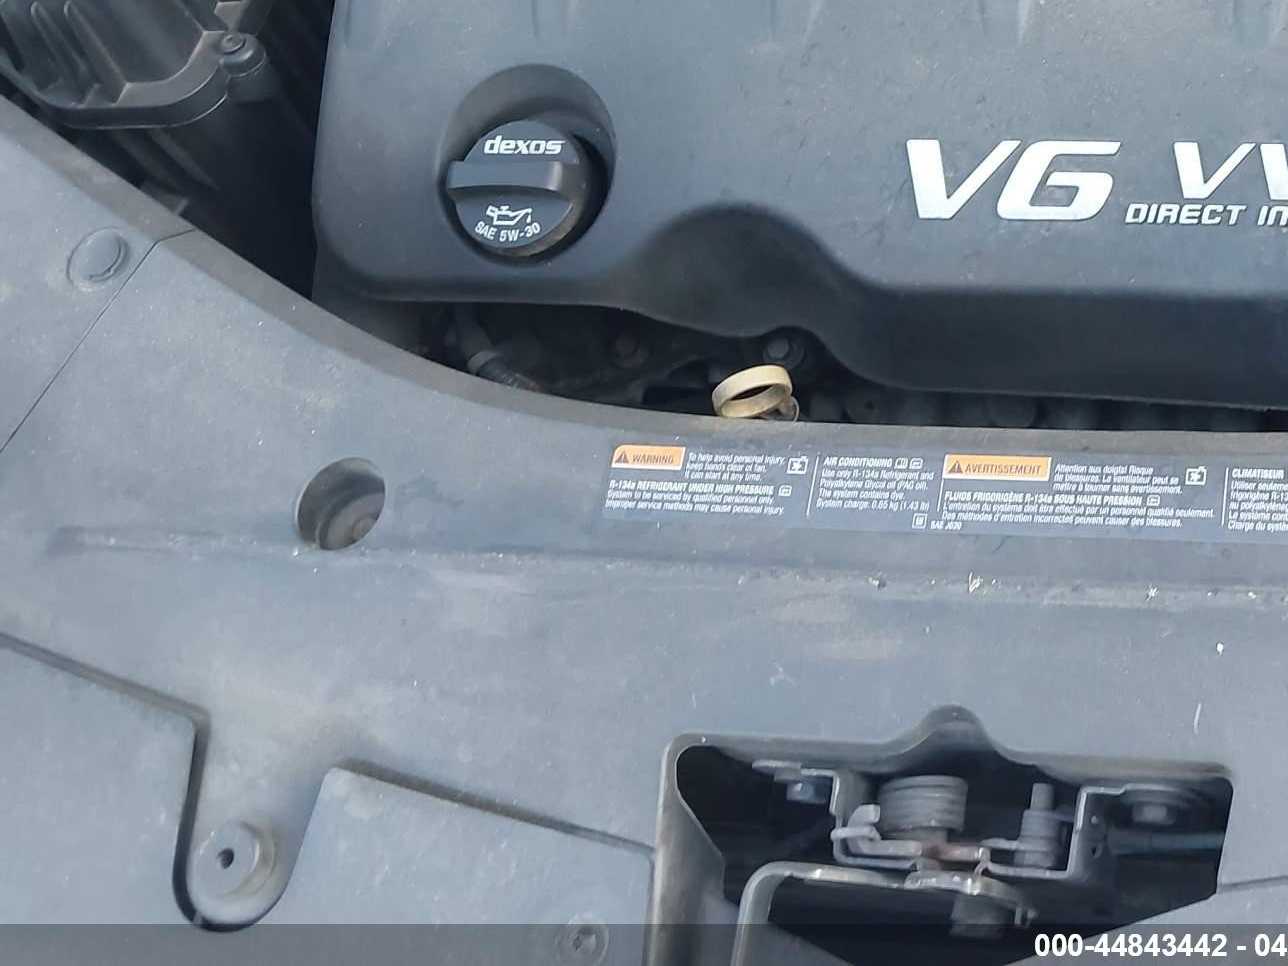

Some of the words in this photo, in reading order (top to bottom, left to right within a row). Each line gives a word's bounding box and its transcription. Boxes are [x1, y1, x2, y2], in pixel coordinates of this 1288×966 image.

[484, 135, 566, 155] dexos
[906, 138, 1121, 220] V6
[1124, 202, 1246, 225] DIRECT
[474, 220, 498, 240] SAE
[499, 221, 541, 243] 5W-30
[632, 453, 674, 465] WARNING
[689, 452, 697, 461] To
[698, 452, 713, 463] help
[713, 453, 733, 463] avoid
[732, 454, 764, 466] personal
[823, 456, 838, 467] AIR
[838, 456, 893, 469] CONDITIONING
[686, 461, 703, 472] keep
[704, 462, 726, 472] hands
[726, 463, 744, 473] clear
[744, 464, 753, 473] of
[965, 463, 1041, 475] AVERTISSEMENT
[1055, 462, 1088, 476] Attention
[1088, 464, 1103, 475] aux
[1232, 468, 1284, 480] CLIMATISEUR
[690, 472, 704, 480] can
[704, 472, 722, 481] start
[721, 472, 730, 481] at
[730, 473, 744, 483] any
[822, 468, 836, 478] Use
[836, 468, 852, 481] only
[852, 469, 880, 480] R-134a
[880, 469, 920, 482] Refrigerant
[920, 471, 935, 482] and
[1054, 472, 1065, 483] de
[1102, 474, 1113, 484] Le
[1112, 474, 1152, 486] ventilateur
[1151, 475, 1170, 487] peut
[1169, 476, 1180, 486] se
[609, 479, 637, 490] R-134a
[636, 480, 689, 493] REFRIGERANT
[688, 482, 716, 494] UNDER
[715, 483, 735, 494] HIGH
[734, 484, 775, 497] PRESSURE
[864, 479, 887, 491] Glycol
[886, 480, 897, 490] oil
[1231, 480, 1257, 491] Utiliser
[607, 489, 634, 501] System
[634, 491, 642, 500] to
[642, 491, 652, 501] be
[652, 492, 684, 502] serviced
[682, 492, 693, 504] by
[691, 493, 723, 505] qualified
[722, 495, 758, 506] personnel
[819, 487, 833, 498] The
[831, 489, 859, 500] system
[859, 490, 890, 501] contains
[945, 490, 973, 502] FLUIDE
[1024, 492, 1053, 505] R-134a
[1053, 493, 1076, 505] SOUS
[1075, 494, 1104, 506] HAUTE
[1103, 494, 1144, 507] PRESSION
[605, 499, 638, 511] Improper
[637, 501, 664, 511] service
[662, 502, 695, 513] methods
[694, 503, 711, 514] may
[710, 504, 733, 514] cause
[731, 504, 764, 516] personal
[1229, 510, 1239, 520] Le
[930, 520, 945, 530] SAE
[1228, 520, 1255, 533] Charge
[1255, 521, 1267, 532] du
